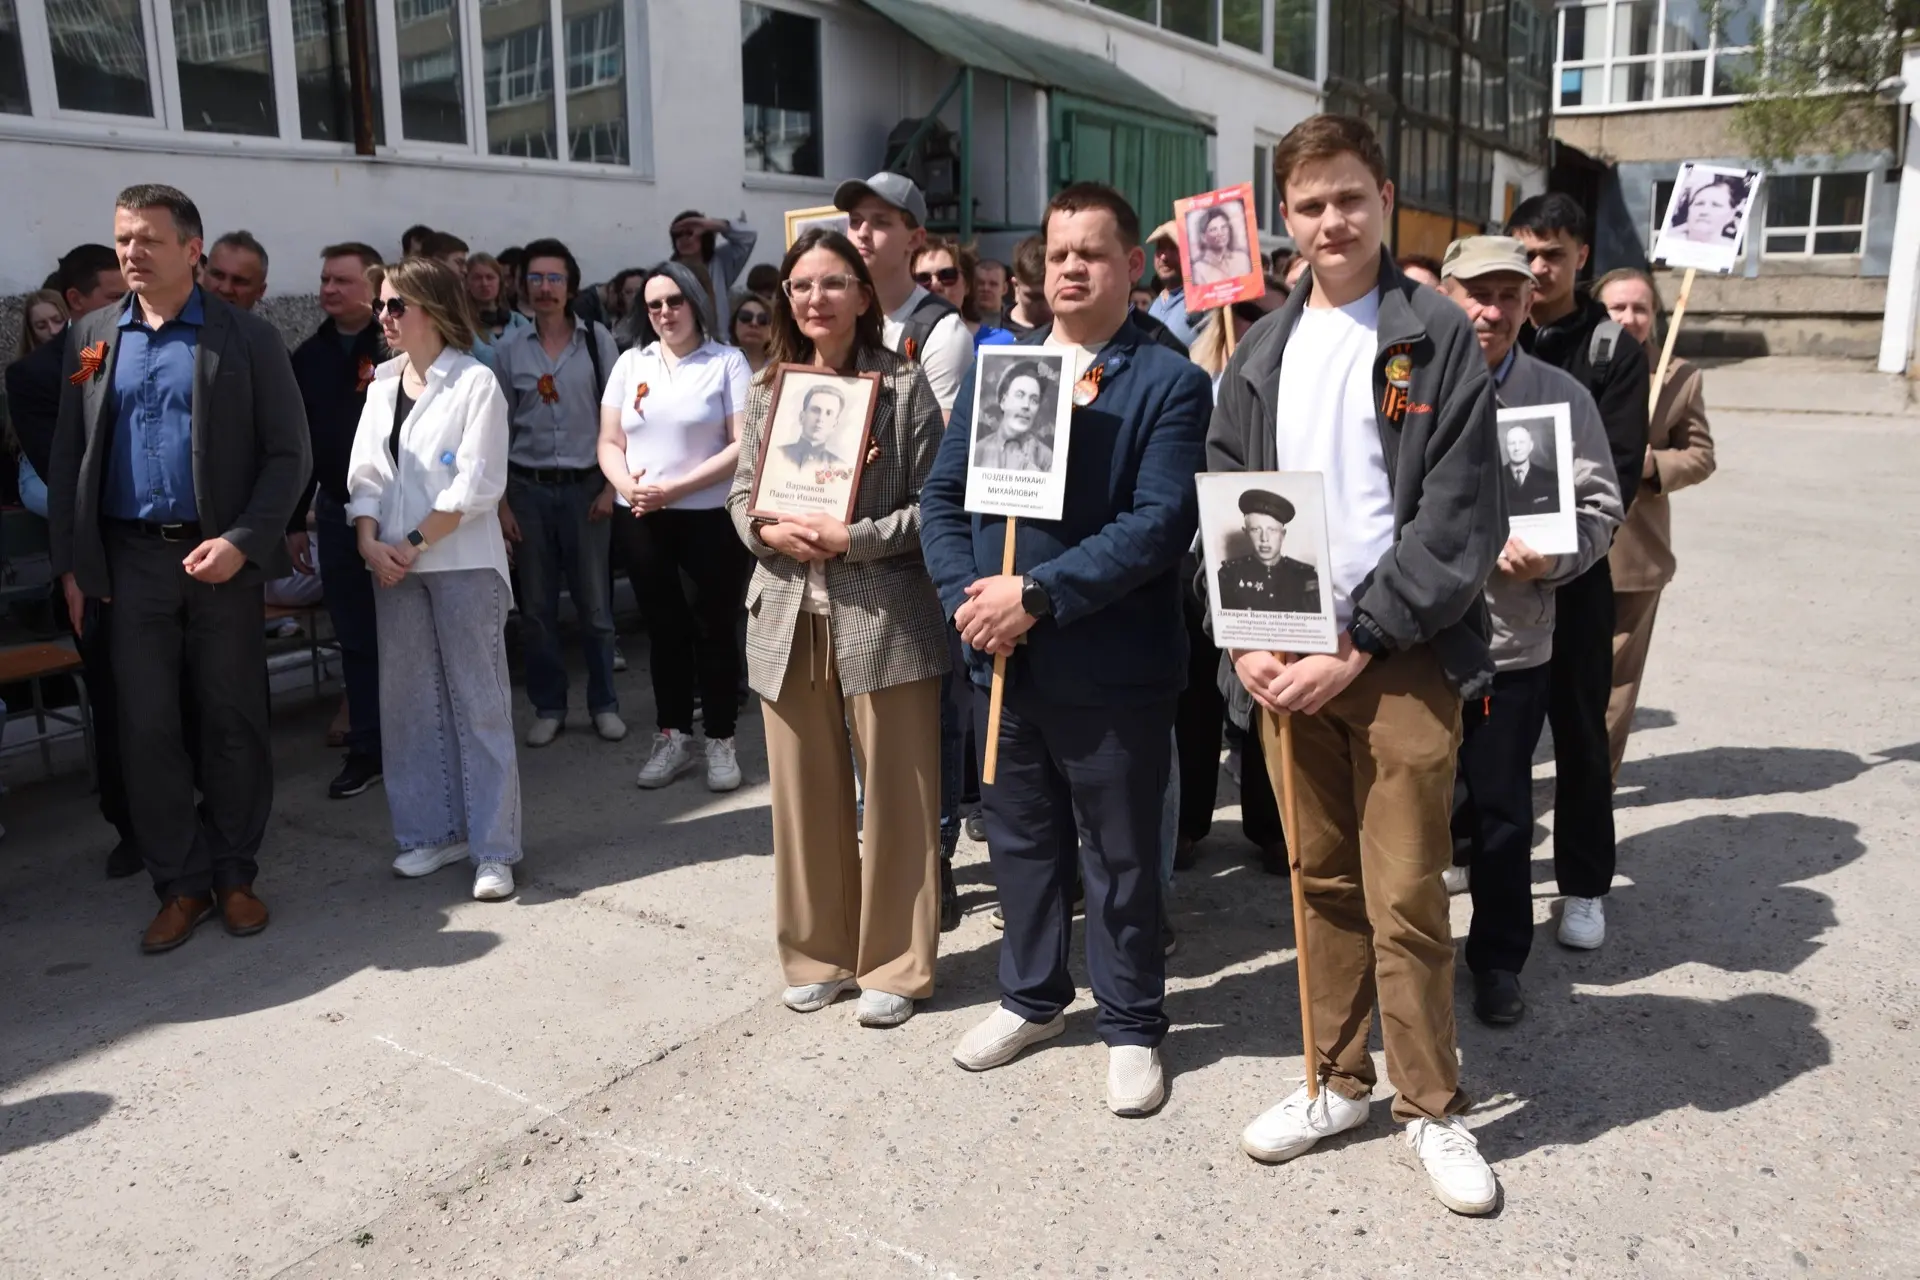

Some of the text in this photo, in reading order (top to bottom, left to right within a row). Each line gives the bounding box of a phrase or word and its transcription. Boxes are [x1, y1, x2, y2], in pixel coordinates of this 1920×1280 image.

[982, 473, 1047, 484] ПОЗДЕЕВ МИХАИЛ
[769, 489, 795, 500] Павел
[796, 491, 838, 505] Иванович
[987, 486, 1039, 498] МИХАЙЛОВИЧ
[1250, 612, 1282, 620] Василий
